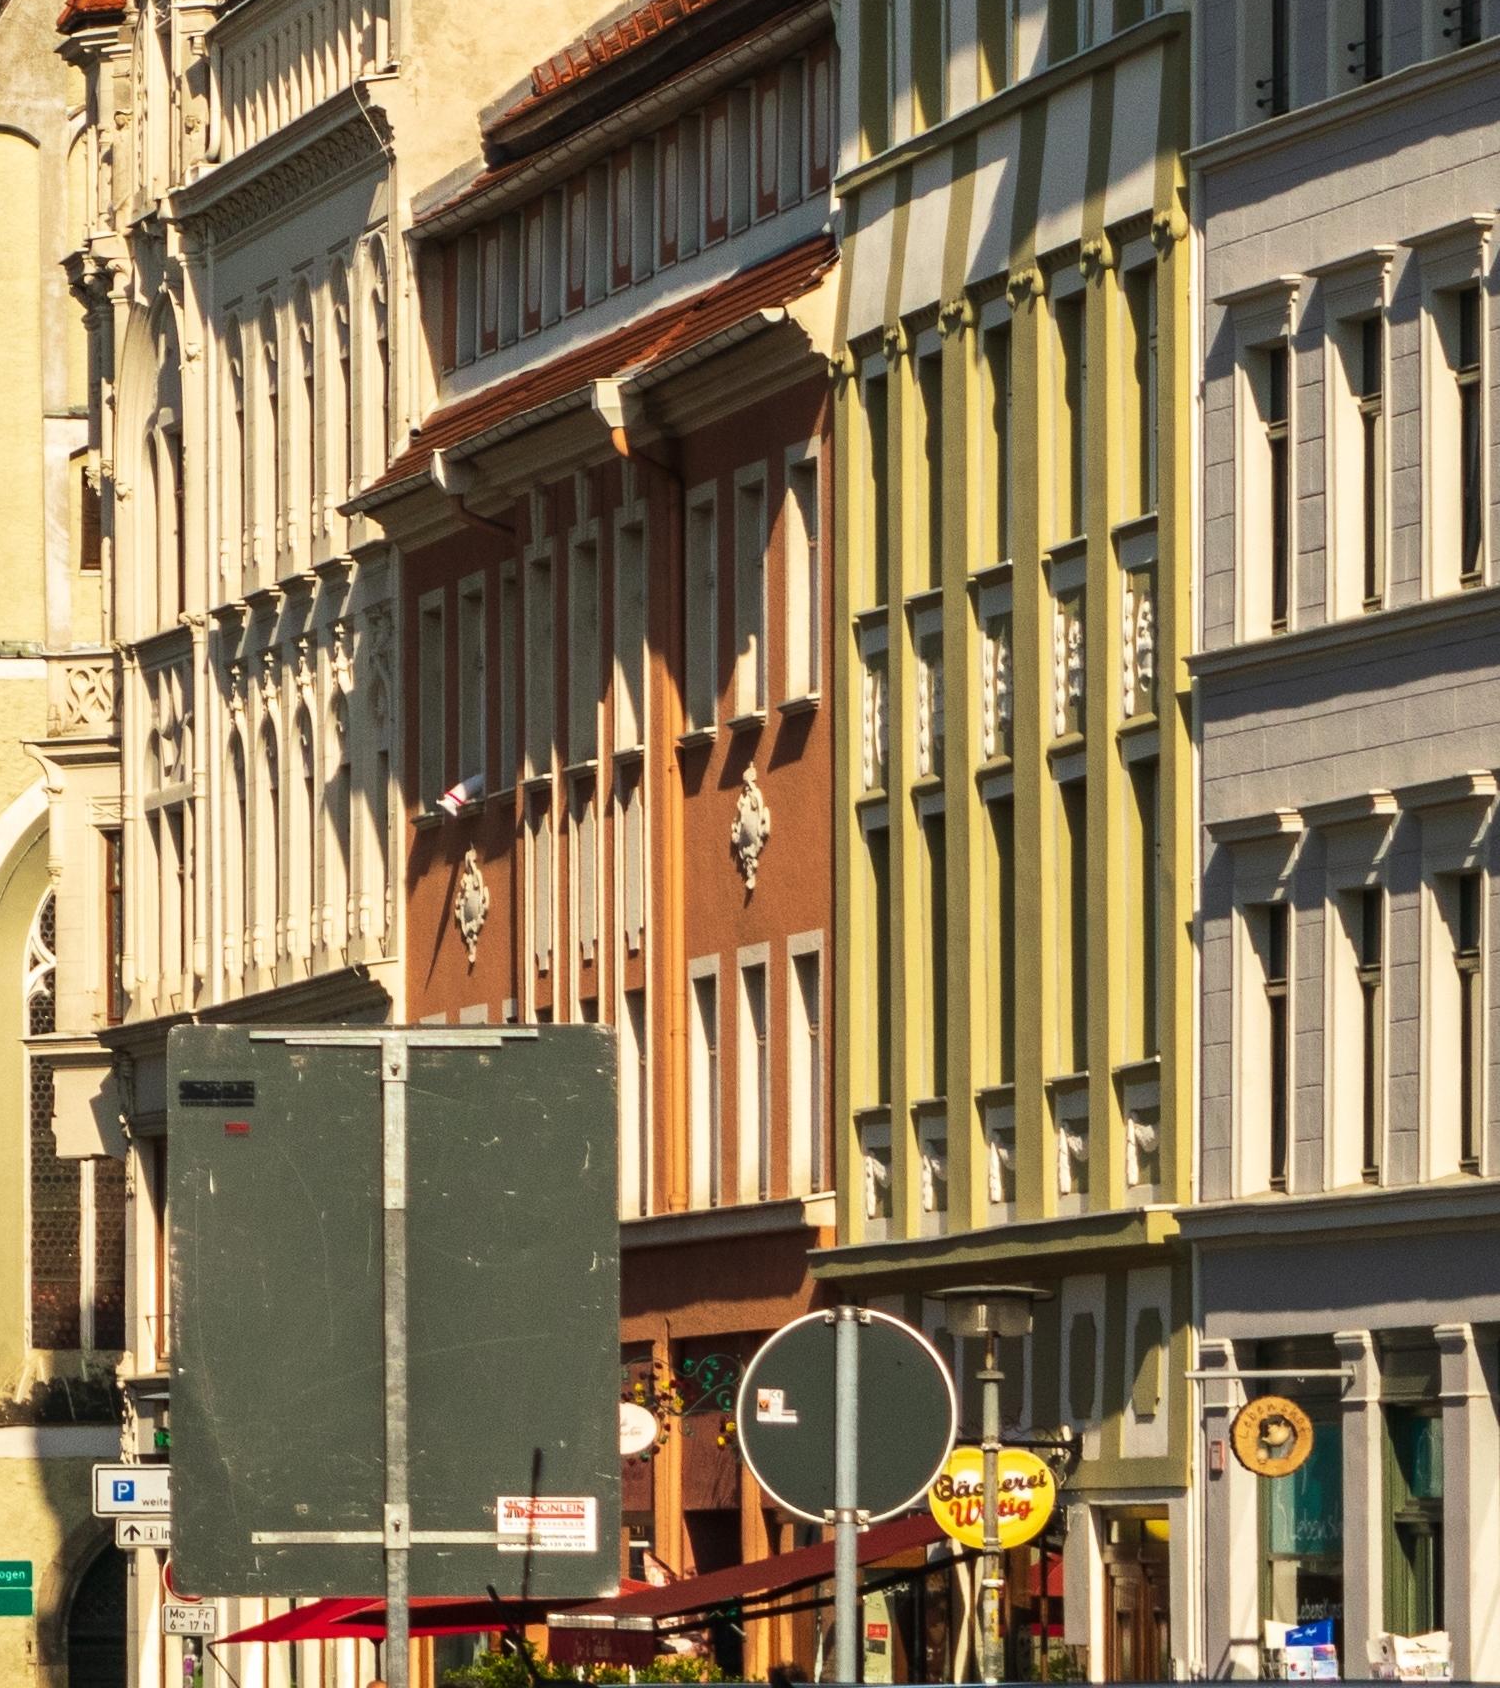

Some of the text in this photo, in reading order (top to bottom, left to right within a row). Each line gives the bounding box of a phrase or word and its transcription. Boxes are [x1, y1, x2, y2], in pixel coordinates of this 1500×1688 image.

[934, 1469, 1047, 1502] Bäcerei
[118, 1483, 130, 1499] P
[141, 1497, 168, 1506] weite
[170, 1609, 186, 1618] Mo
[198, 1609, 210, 1618] Fr
[170, 1621, 176, 1630] 6
[190, 1621, 199, 1630] 17
[203, 1621, 210, 1630] h
